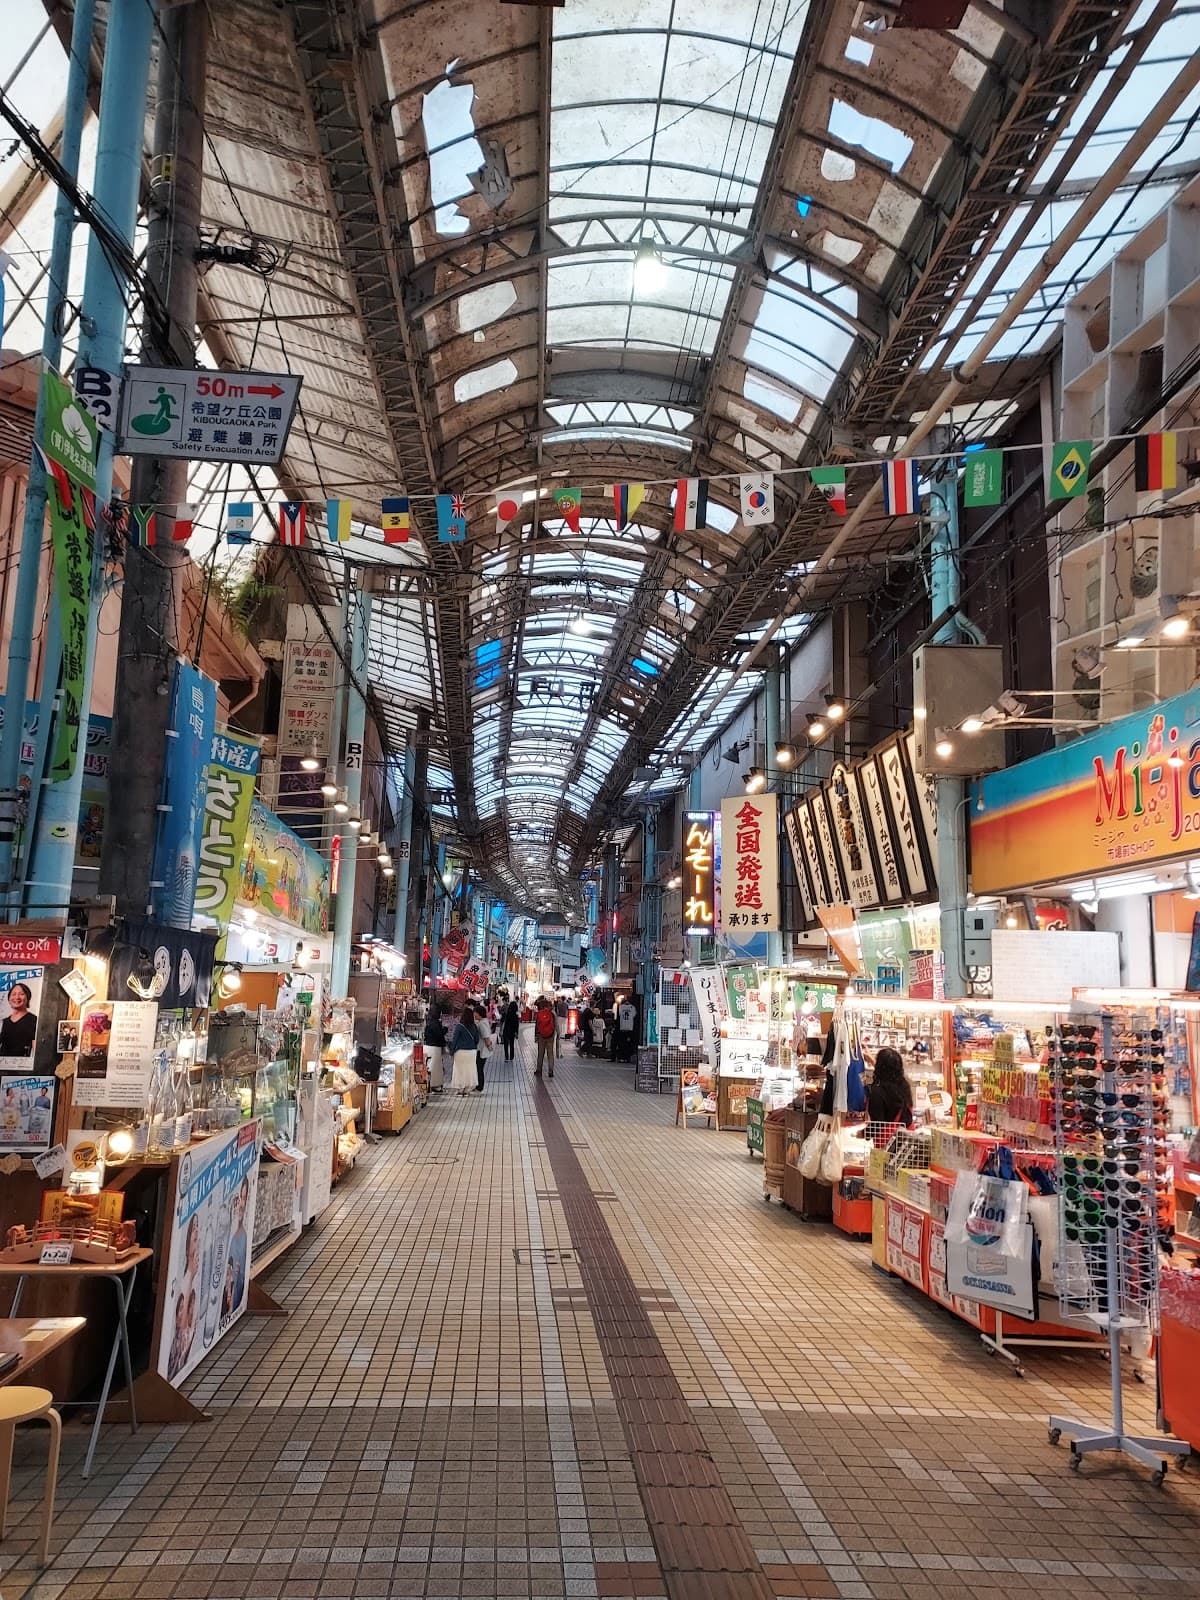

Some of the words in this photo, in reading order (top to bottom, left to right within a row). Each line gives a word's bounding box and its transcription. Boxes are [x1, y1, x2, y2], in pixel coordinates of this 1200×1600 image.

[76, 367, 112, 396] B
[196, 377, 244, 398] 50m
[192, 401, 282, 420] 希望ケ丘公園
[193, 415, 256, 428] KIBOUGAOKA
[257, 420, 277, 429] Park
[187, 427, 279, 447] 避難場所
[172, 441, 202, 452] Safety
[204, 444, 253, 455] Evacuation
[254, 446, 276, 456] Area
[347, 742, 362, 755] B
[346, 756, 361, 769] 21
[867, 766, 898, 887] じーまーみ豆腐
[192, 769, 242, 928] さとう
[734, 801, 763, 909] 全国発送
[684, 822, 713, 921] んそーれ
[728, 912, 772, 926] 承ります
[2, 940, 23, 951] Out
[700, 976, 721, 1069] じーまーみ豆
